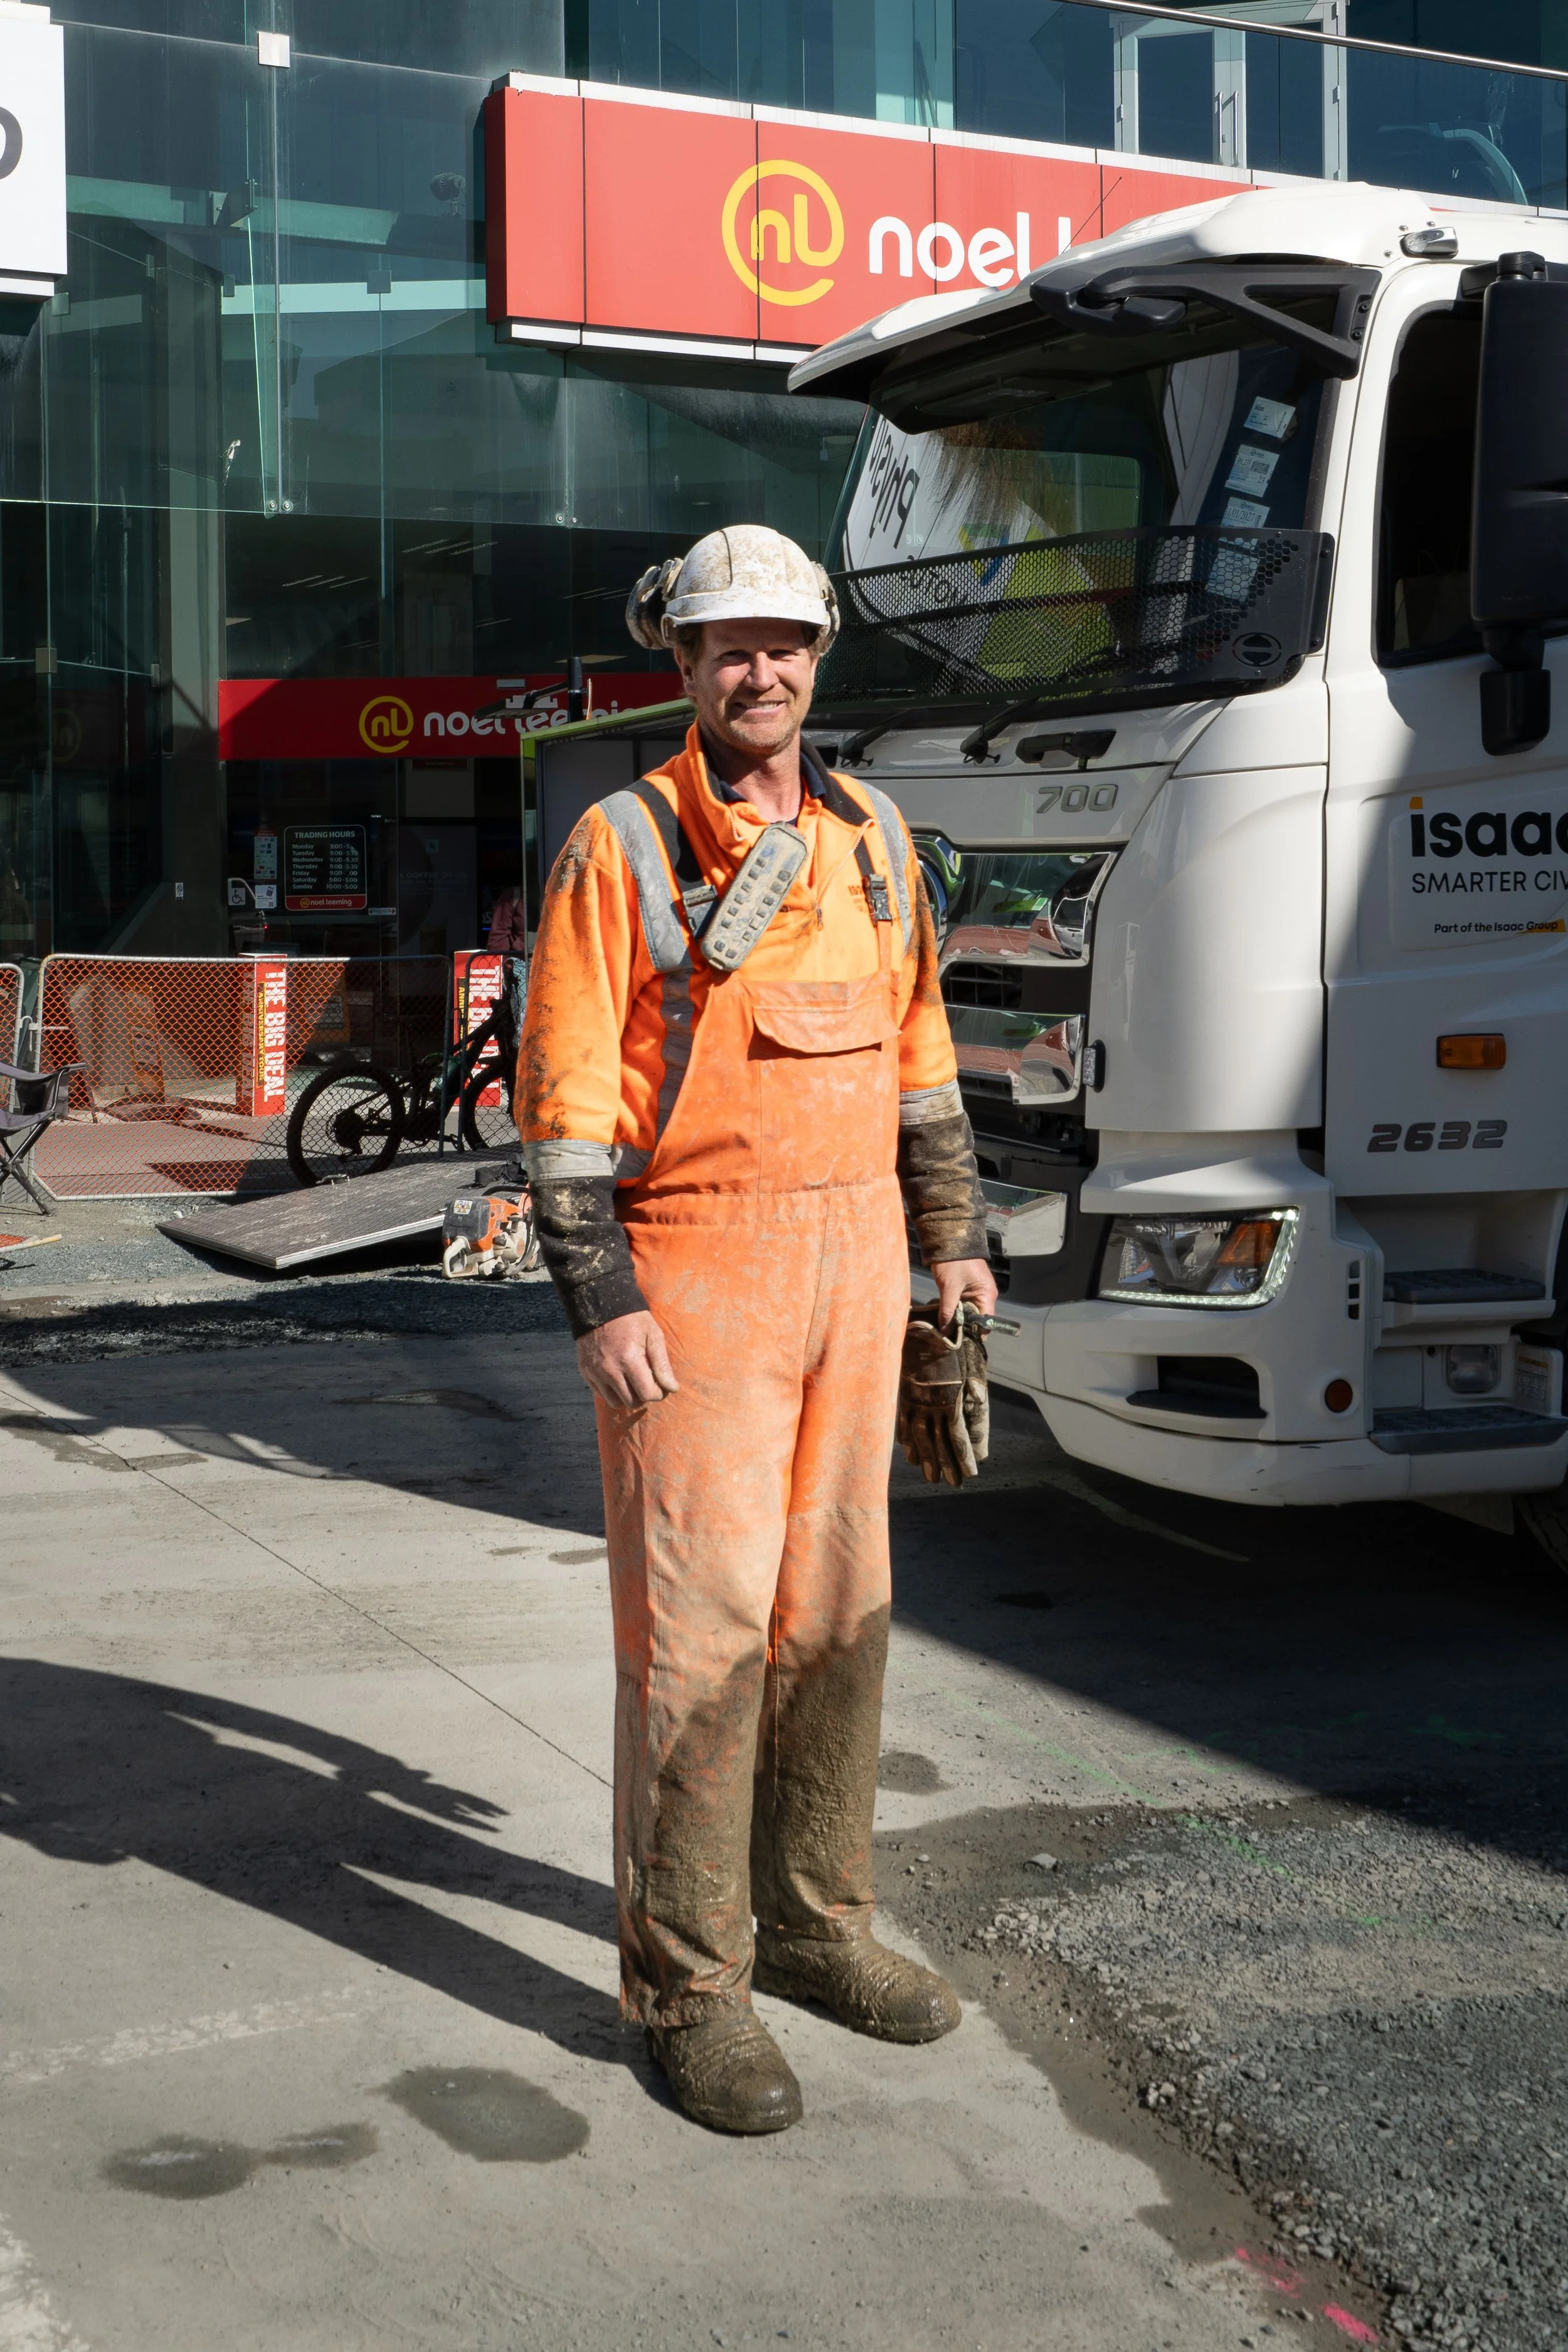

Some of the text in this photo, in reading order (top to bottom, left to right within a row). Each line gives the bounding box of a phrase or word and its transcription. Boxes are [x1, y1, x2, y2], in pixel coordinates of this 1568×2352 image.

[869, 211, 1032, 287] noel
[1036, 784, 1119, 813] 700
[1412, 871, 1527, 893] SMARTER
[326, 898, 352, 906] leeming
[1434, 921, 1559, 933] Part of the Isaac Group
[469, 965, 500, 1003] THE
[264, 968, 286, 1103] THE BIG DEAL
[1367, 1120, 1508, 1153] 2632
